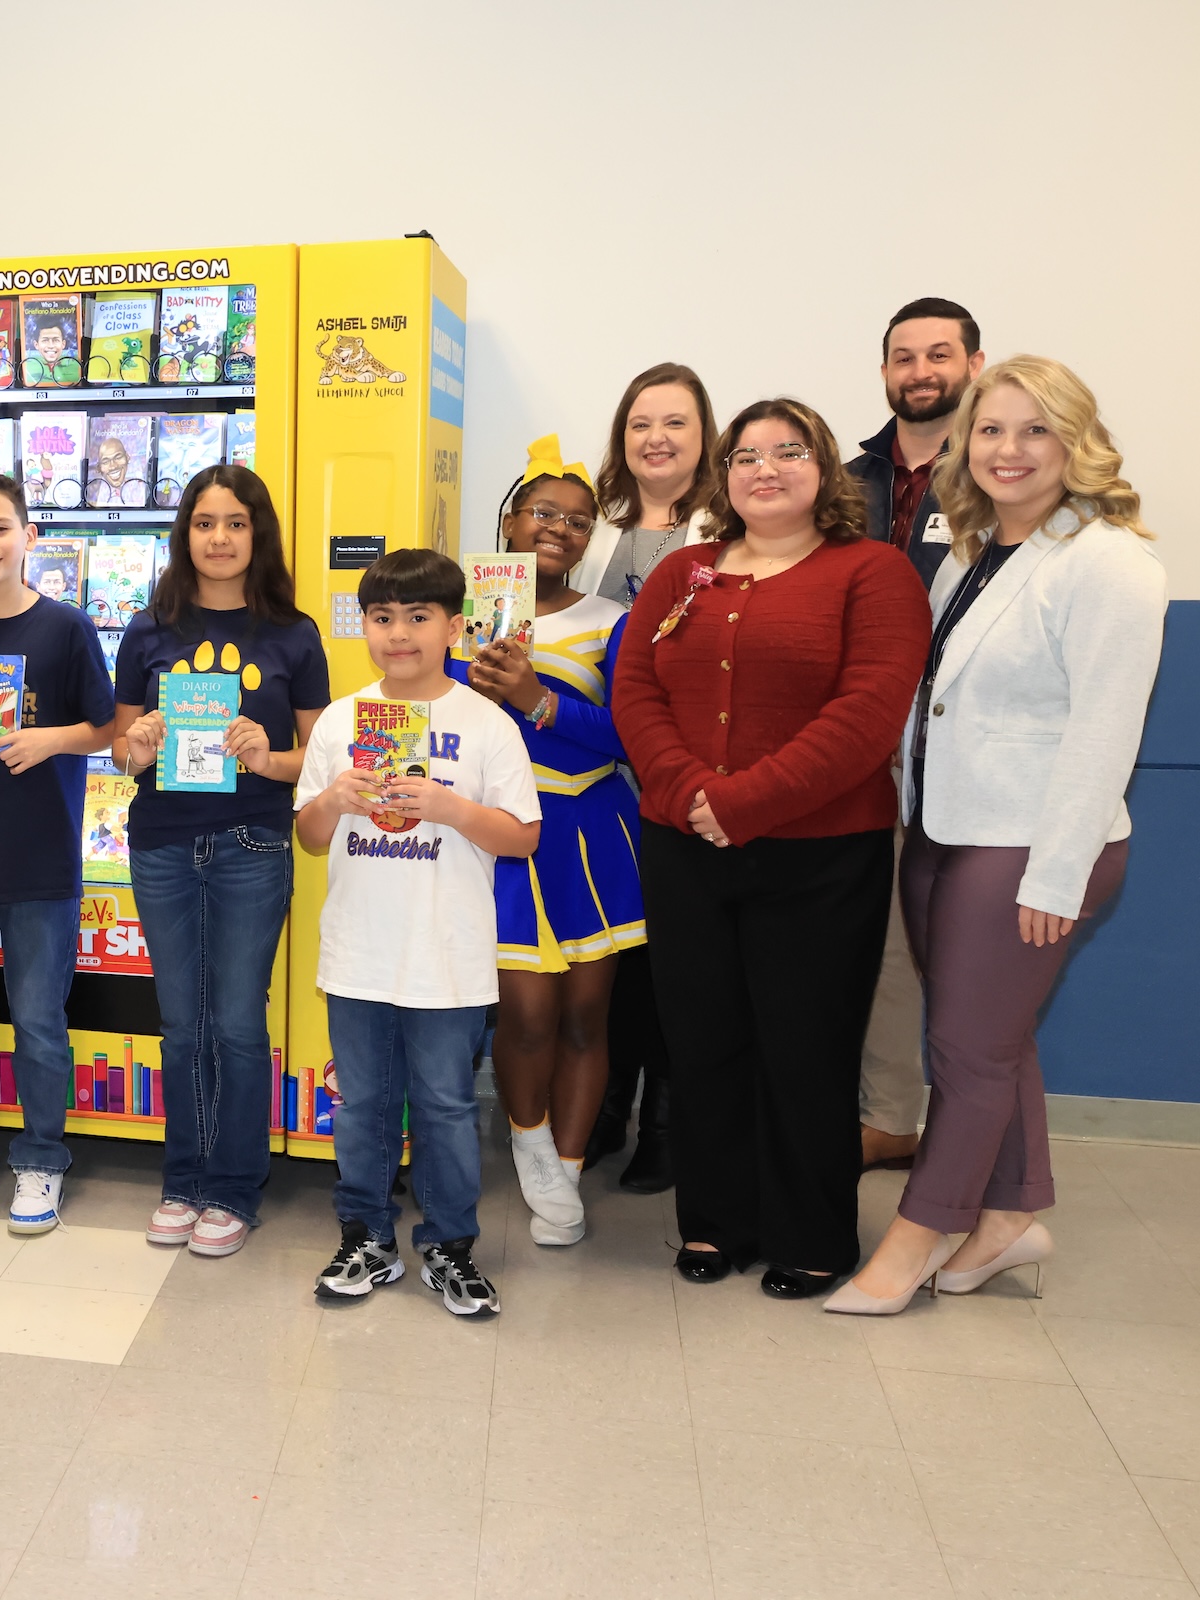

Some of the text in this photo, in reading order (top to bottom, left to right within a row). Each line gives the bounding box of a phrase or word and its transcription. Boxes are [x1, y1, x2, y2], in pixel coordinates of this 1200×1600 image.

[99, 301, 147, 312] Confessions
[166, 296, 223, 307] BAD KITTY
[116, 311, 142, 321] Class
[105, 322, 139, 332] Clown
[316, 317, 367, 331] ASHBEL
[188, 389, 198, 397] 07
[317, 387, 404, 398] ELEMENTARY SCHOOL
[164, 419, 198, 427] DRAGON
[36, 427, 65, 439] LOLA
[117, 427, 143, 436] Jordan?
[29, 439, 73, 453] LEVINE
[95, 559, 114, 569] Hog
[124, 563, 143, 572] Log
[473, 564, 527, 580] SIMON B.
[182, 682, 221, 691] DIARIO
[173, 701, 207, 716] Wimpy
[208, 700, 227, 714] Kid
[357, 701, 406, 717] PRESS
[357, 715, 409, 734] START!
[347, 831, 442, 861] Basketball
[105, 925, 150, 957] SH
